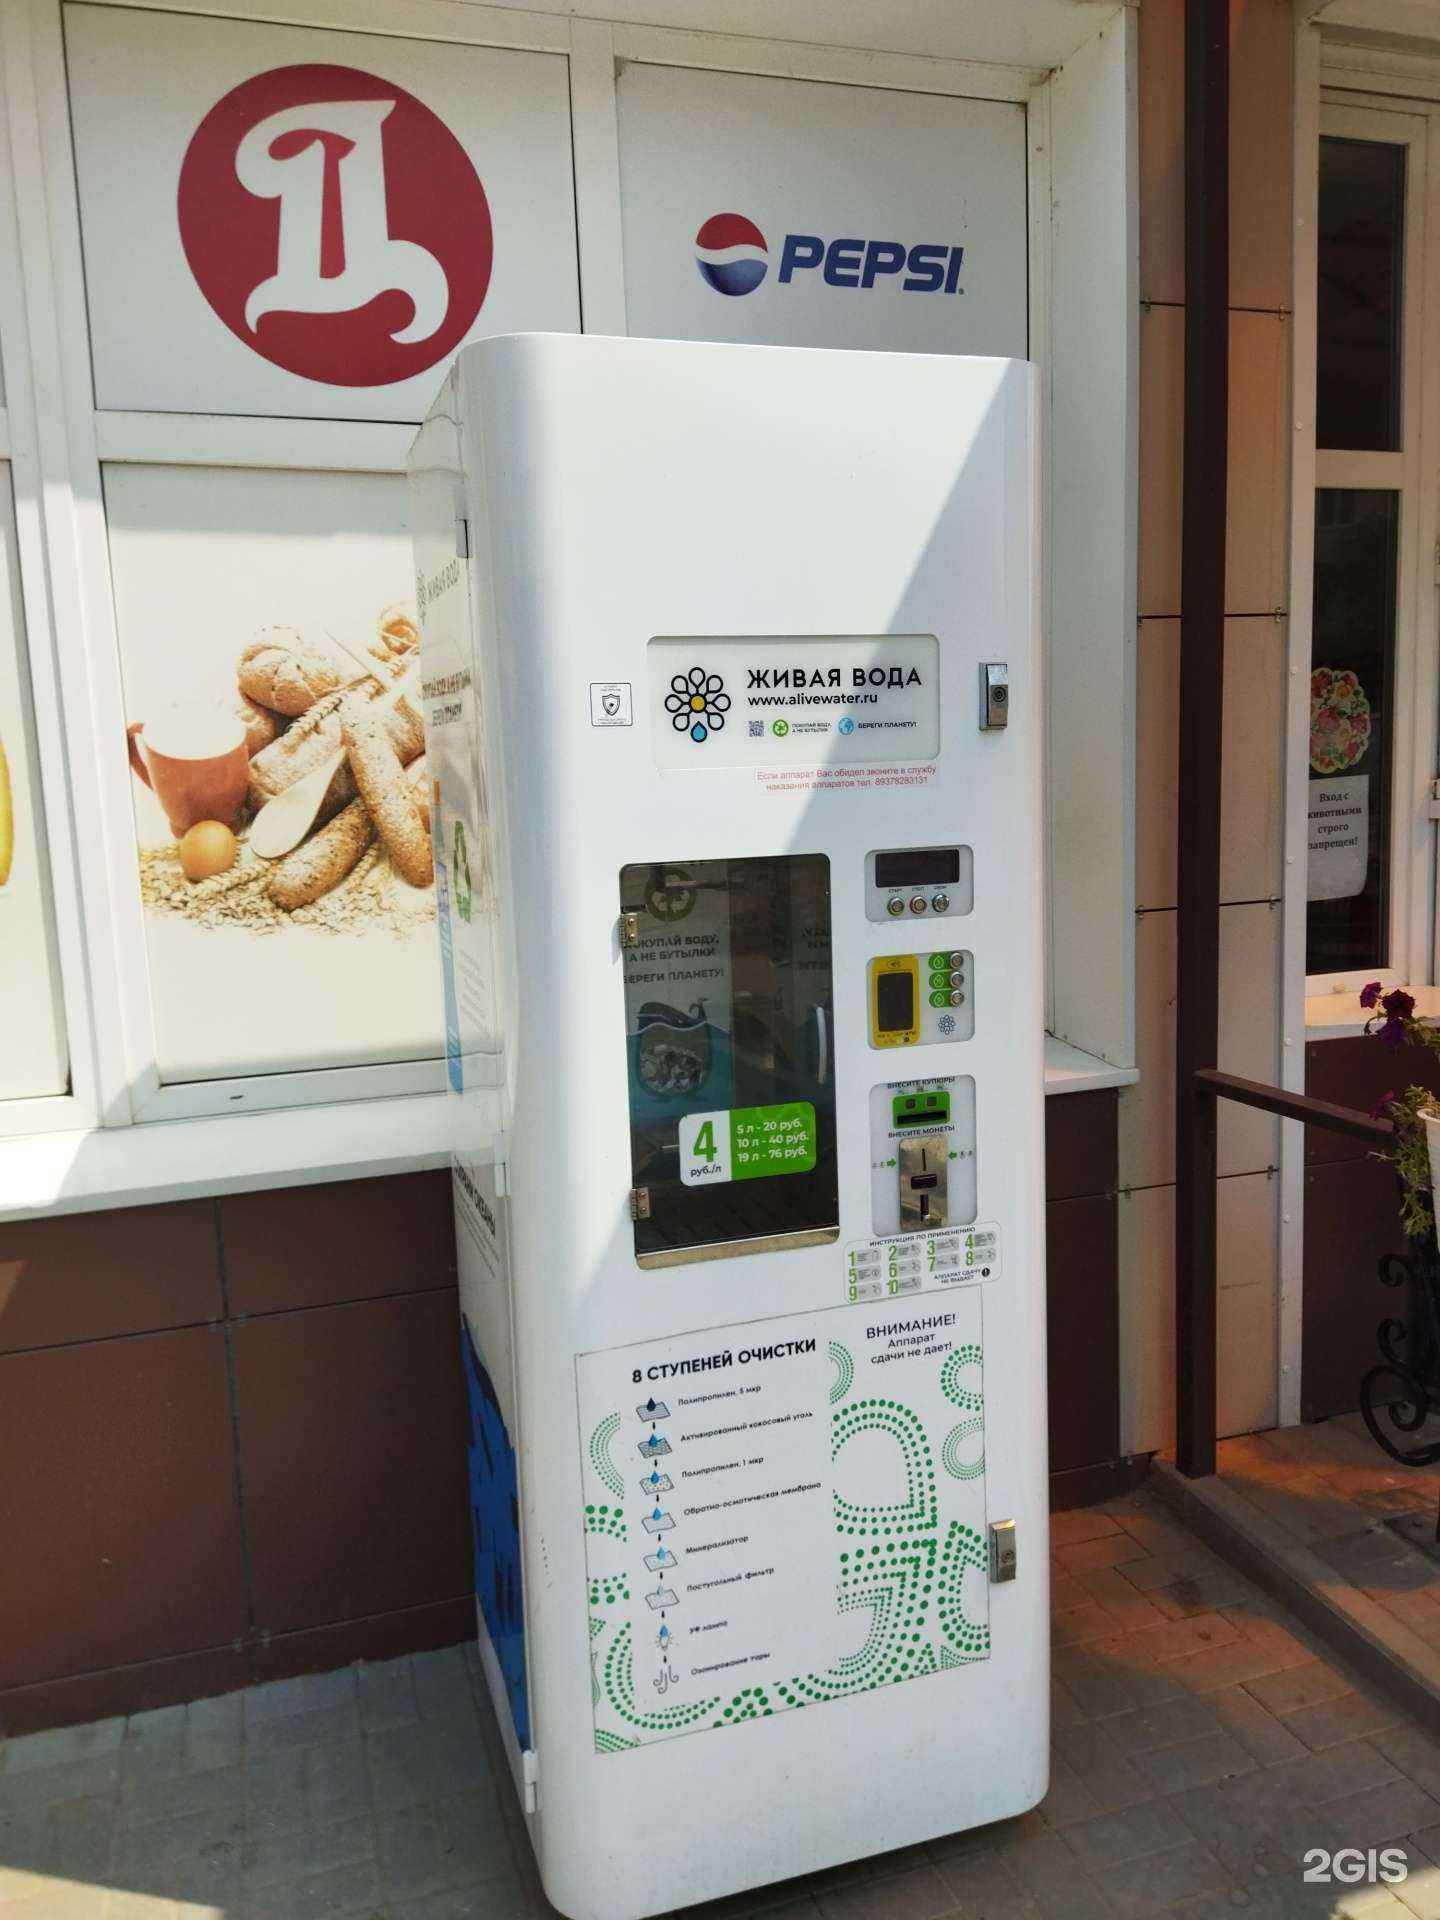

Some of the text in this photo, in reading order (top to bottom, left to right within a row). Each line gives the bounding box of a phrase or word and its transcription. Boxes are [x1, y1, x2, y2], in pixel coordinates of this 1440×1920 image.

[778, 234, 964, 294] PEPSI
[747, 667, 922, 690] ЖИВАЯ ВОДА
[748, 692, 878, 706] www.alivewater.ru
[816, 769, 832, 778] Вас
[834, 767, 865, 778] обидел
[866, 767, 898, 777] звоните
[907, 765, 937, 777] службу
[811, 780, 854, 789] аппаратов
[1320, 792, 1343, 802] Вход
[1318, 823, 1349, 835] строго
[629, 947, 715, 962] А НЕ БУТЫЛКИ
[669, 968, 724, 980] ПЛАНЕТУ!
[887, 1080, 921, 1089] ВНЕСИТЕ
[737, 1124, 744, 1134] 5
[745, 1125, 754, 1134] л
[763, 1121, 777, 1131] 20
[779, 1118, 803, 1132] руб.
[888, 1125, 955, 1139] ВНЕСИТЕ МОНЕТЫ
[693, 1120, 718, 1163] 4
[737, 1138, 749, 1148] 10
[751, 1139, 760, 1147] л
[769, 1134, 784, 1144] 40
[786, 1131, 809, 1146] руб.
[737, 1152, 749, 1162] 19
[752, 1152, 760, 1161] л
[769, 1149, 782, 1159] 76
[784, 1146, 808, 1160] руб.
[690, 1163, 722, 1178] руб./л
[869, 1235, 915, 1247] ИНСТРУКЦИЯ
[927, 1227, 976, 1239] ПРИМЕНЕНИЮ
[965, 1233, 974, 1249] 4
[889, 1245, 897, 1262] 2
[927, 1240, 935, 1255] 3
[848, 1250, 855, 1267] 1
[927, 1256, 936, 1272] 7
[966, 1251, 974, 1266] 8
[849, 1268, 857, 1284] 5
[889, 1262, 897, 1278] 6
[849, 1286, 857, 1301] 9
[886, 1279, 898, 1295] 10
[866, 1313, 956, 1339] ВНИМАНИЕ!
[888, 1333, 936, 1349] Аппарат
[632, 1338, 816, 1384] 8 СТУПЕНЕЙ ОЧИСТКИ
[871, 1341, 952, 1365] сдачи не дает!
[746, 1385, 762, 1394] мкр
[680, 1411, 813, 1442] Активированный кокосовый уголь
[749, 1457, 764, 1465] мкр
[683, 1482, 822, 1516] Обратно-осмотическая мембрана
[686, 1536, 749, 1554] Минерализатор
[687, 1567, 774, 1592] Постугольный фильтр
[702, 1620, 728, 1631] лампа
